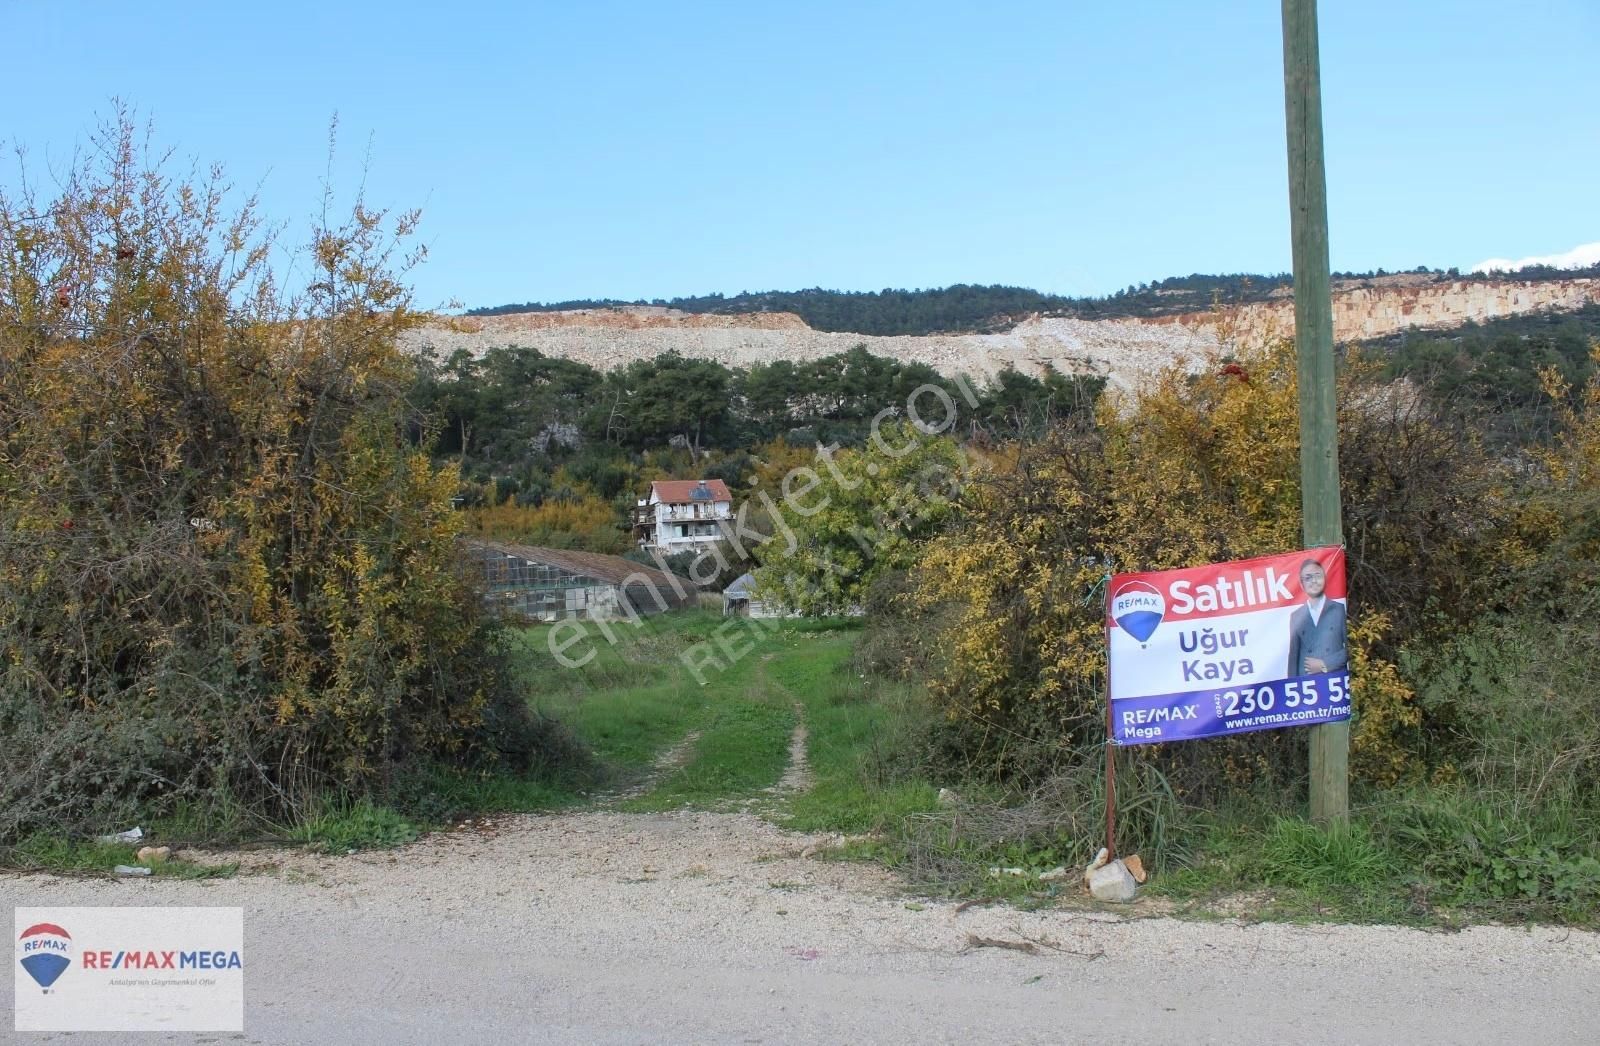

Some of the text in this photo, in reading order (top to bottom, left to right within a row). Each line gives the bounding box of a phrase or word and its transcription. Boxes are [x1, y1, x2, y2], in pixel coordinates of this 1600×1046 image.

[1168, 567, 1294, 614] Satılık
[1118, 597, 1158, 611] RE/MAX
[1178, 627, 1249, 655] Uğur
[1181, 657, 1254, 682] Kaya
[1223, 686, 1275, 716] 230
[1284, 680, 1319, 707] 55
[1123, 704, 1198, 725] RE/MAX
[1124, 725, 1162, 738] Mega
